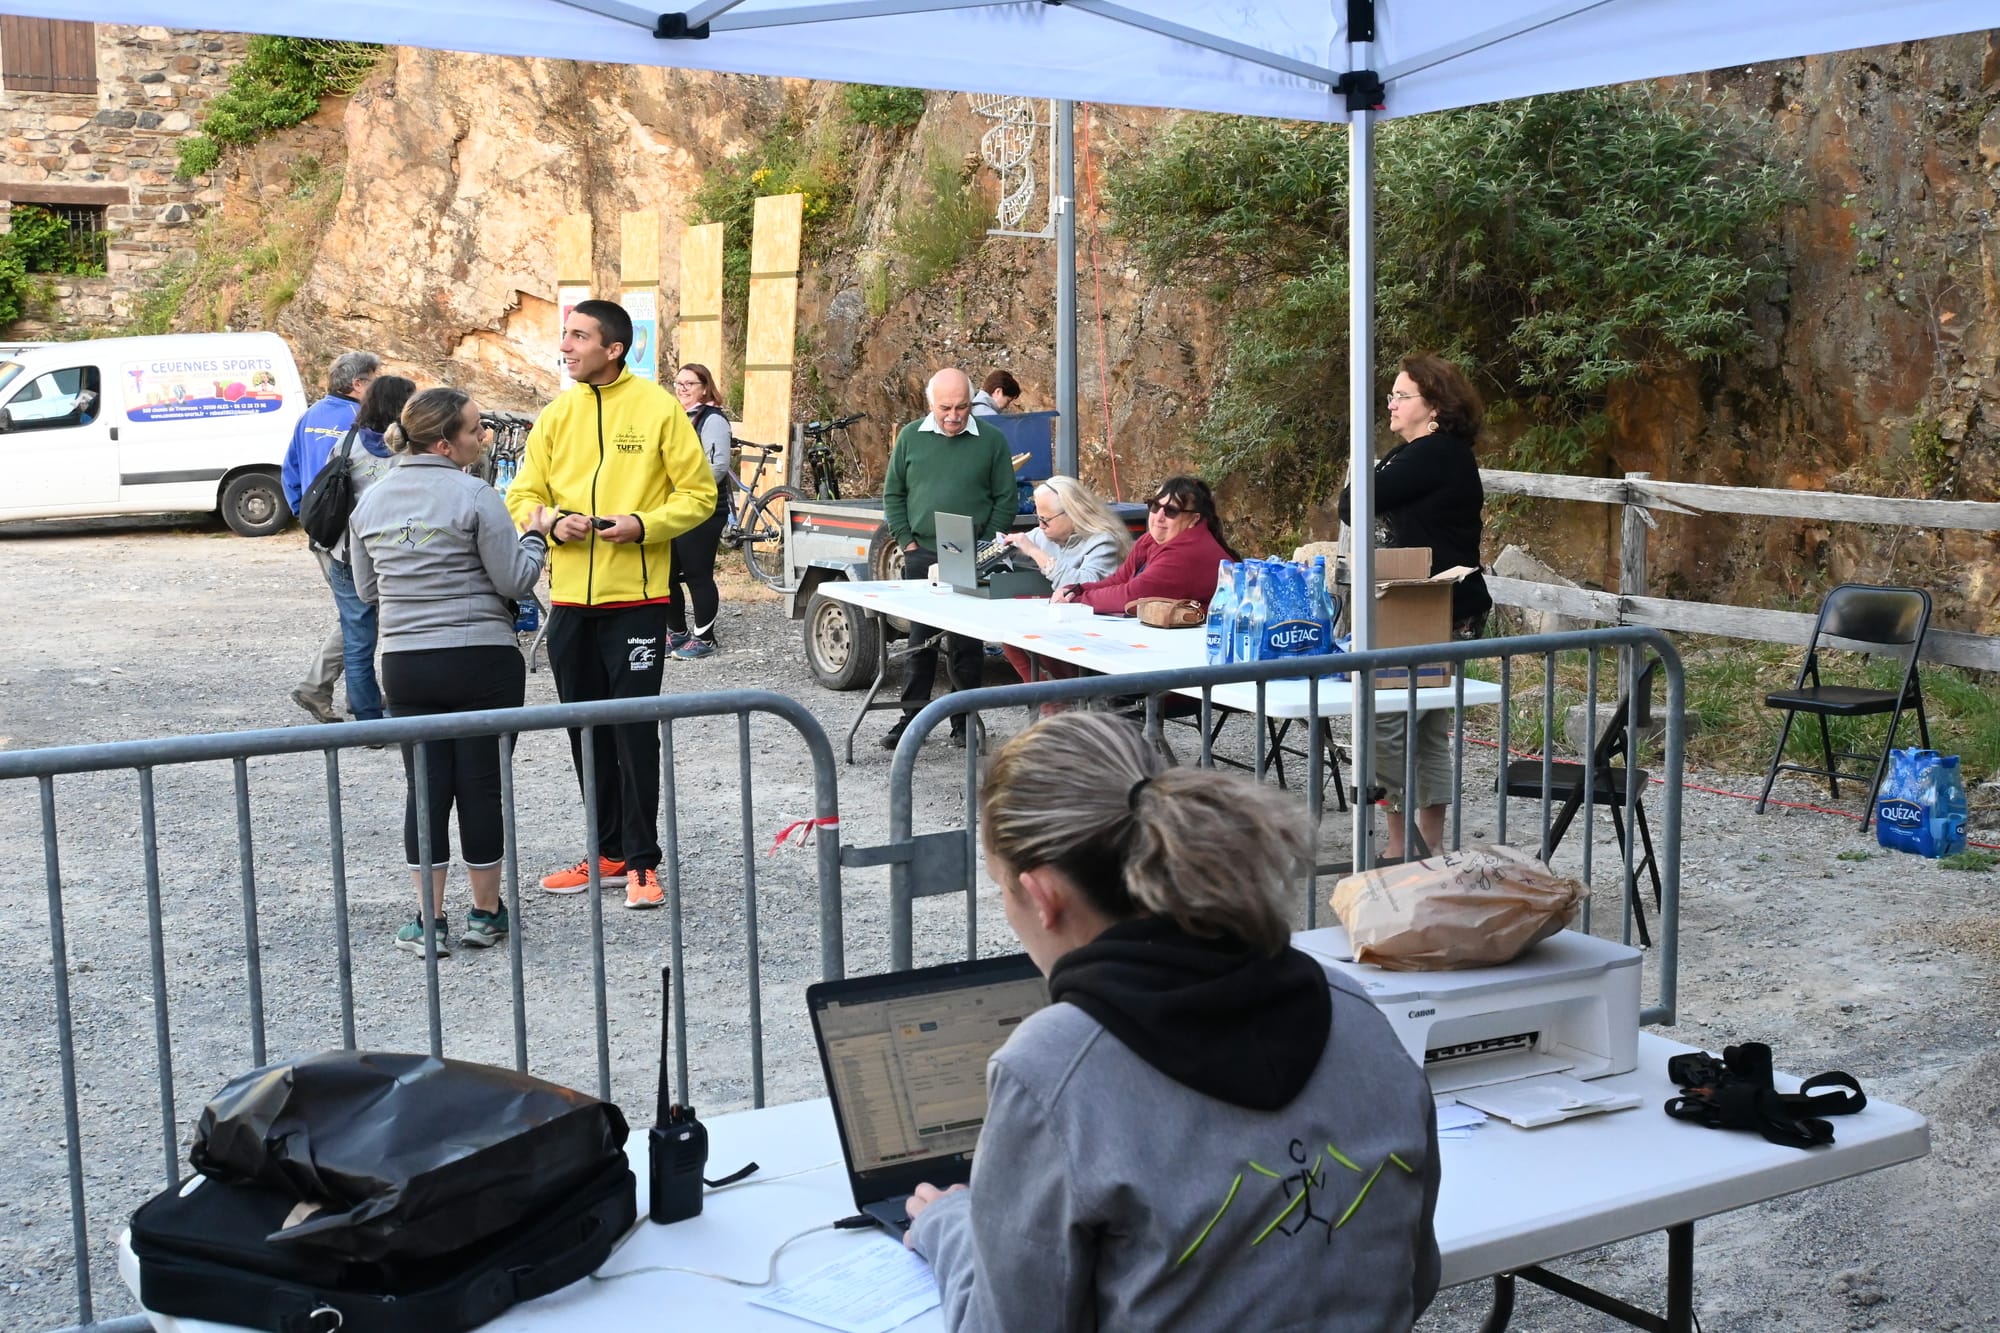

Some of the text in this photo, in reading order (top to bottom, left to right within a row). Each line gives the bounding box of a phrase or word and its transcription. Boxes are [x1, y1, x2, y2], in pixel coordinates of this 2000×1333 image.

[222, 359, 272, 371] SPORTS
[627, 637, 656, 645] uhlsport
[1270, 626, 1320, 648] QUÉZAC
[1881, 803, 1922, 823] QUÉZAC
[1408, 1008, 1436, 1019] Canon
